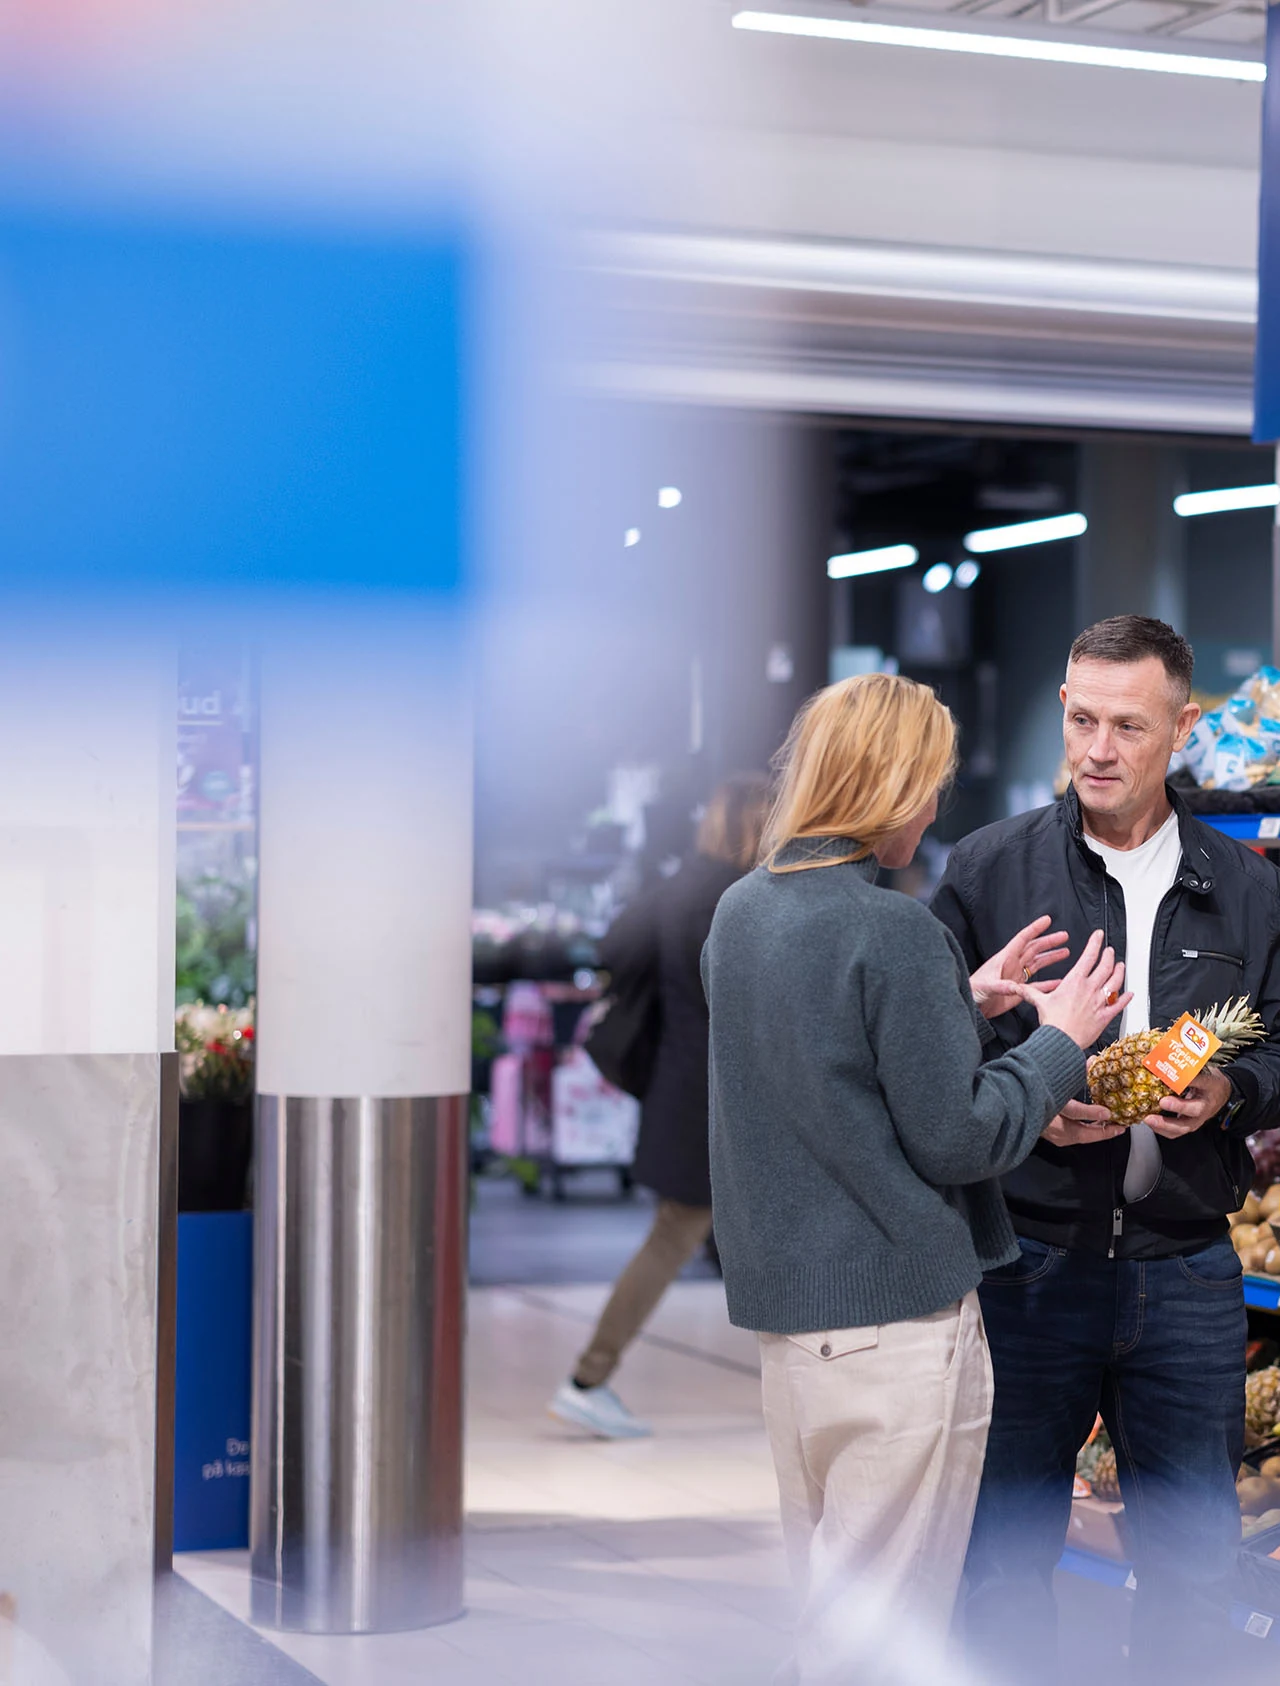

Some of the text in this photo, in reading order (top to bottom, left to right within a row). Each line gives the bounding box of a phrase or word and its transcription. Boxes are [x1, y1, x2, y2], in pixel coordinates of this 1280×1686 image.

[1186, 1027, 1206, 1048] Dole
[1168, 1039, 1200, 1067] Tropical
[1168, 1052, 1189, 1070] Gold
